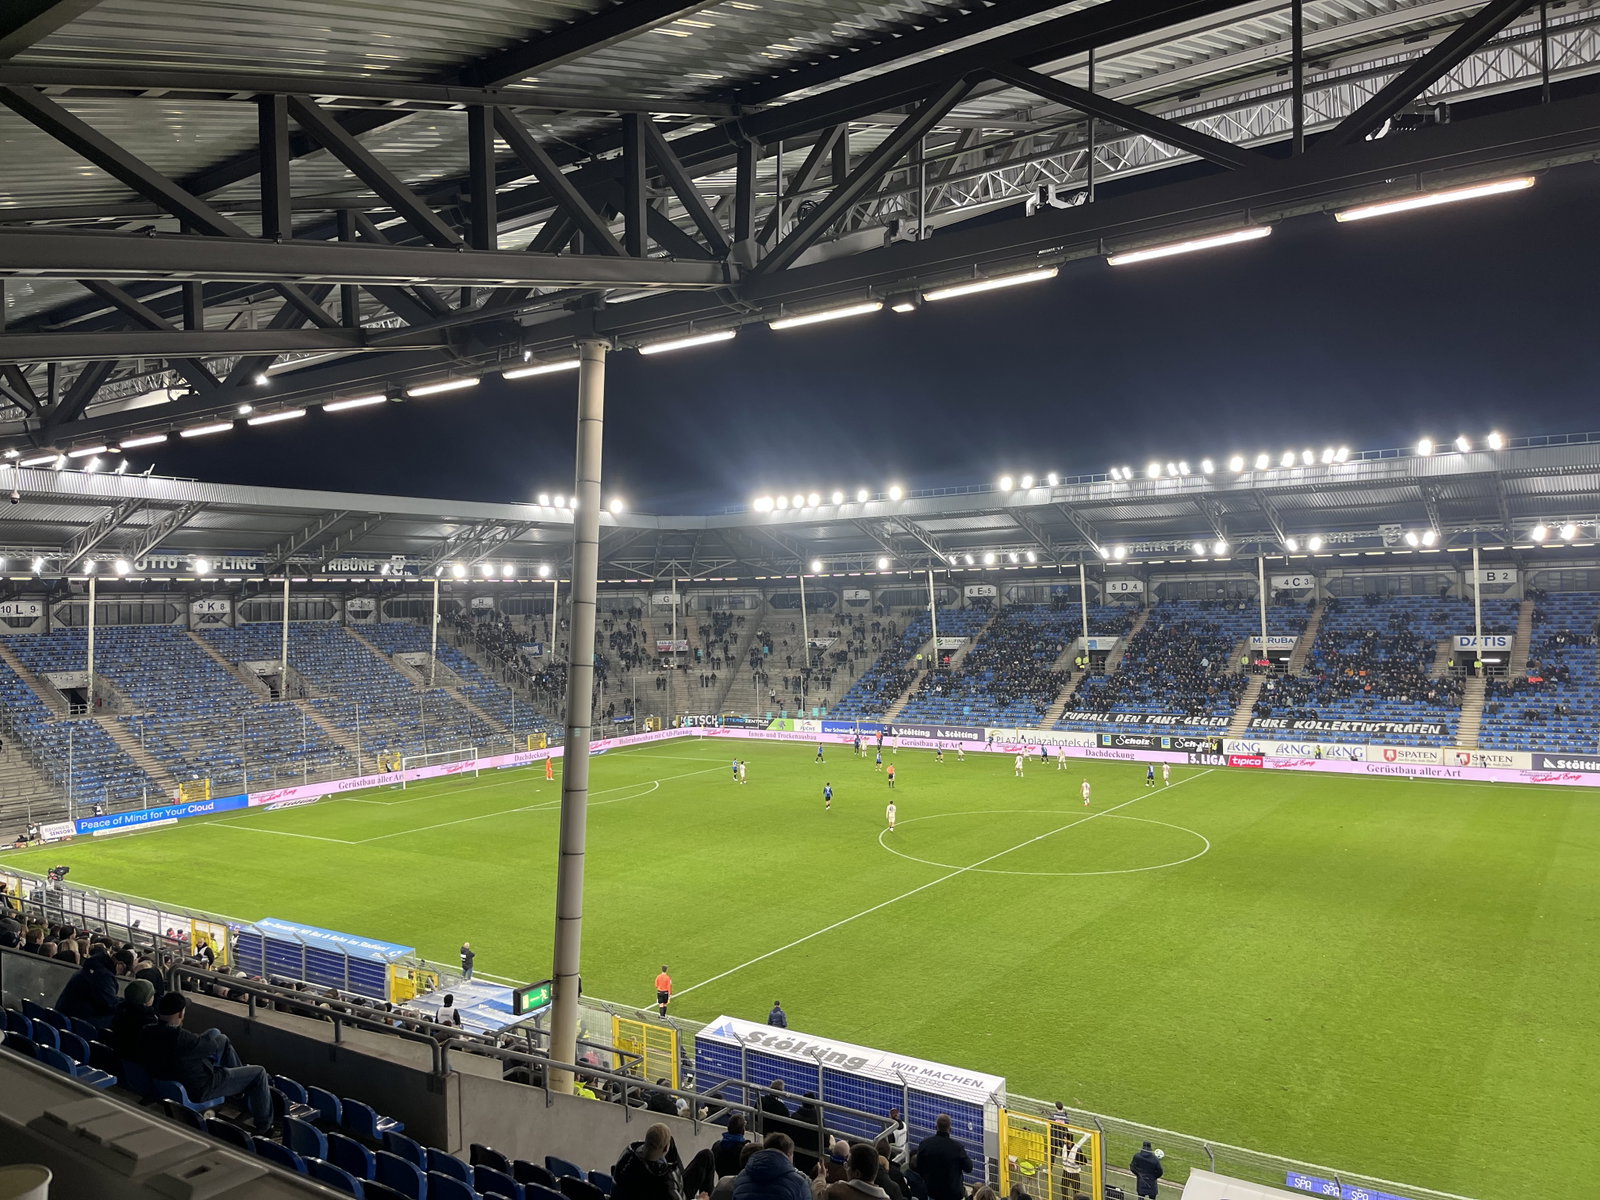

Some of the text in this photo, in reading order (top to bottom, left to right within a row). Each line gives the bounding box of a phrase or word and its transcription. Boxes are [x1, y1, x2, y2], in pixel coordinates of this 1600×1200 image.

[1486, 571, 1509, 581] B 2
[1111, 583, 1117, 591] 5
[1121, 582, 1129, 591] D
[1292, 577, 1301, 587] C
[854, 590, 861, 599] F
[977, 587, 984, 595] E
[663, 595, 670, 603] G
[0, 604, 36, 615] 10 L 9
[207, 602, 215, 611] K
[219, 602, 226, 611] 8
[1252, 636, 1295, 644] MRUBA
[1459, 636, 1507, 647] DATIS
[1115, 713, 1141, 723] DEN
[1252, 718, 1289, 729] EURE
[899, 728, 978, 740] Stölting Stölting
[901, 739, 934, 748] Gerüstbau
[1028, 735, 1096, 748] plazahotels.de
[1115, 734, 1151, 746] Scholz
[1085, 748, 1135, 760] Dachdeckung
[1189, 753, 1226, 766] 3. LIGA
[1397, 751, 1437, 759] SPATEN
[1231, 756, 1262, 767] tipico
[1366, 764, 1461, 777] Gerüstbau aller Art
[338, 777, 376, 790] Gerüstbau
[81, 820, 111, 830] Peace
[112, 816, 122, 825] of
[124, 813, 148, 824] Mind
[150, 811, 163, 820] for
[165, 808, 187, 817] Your
[187, 802, 215, 813] Cloud
[742, 1031, 869, 1070] Stölting
[890, 1061, 985, 1089] WIR MACHEN.
